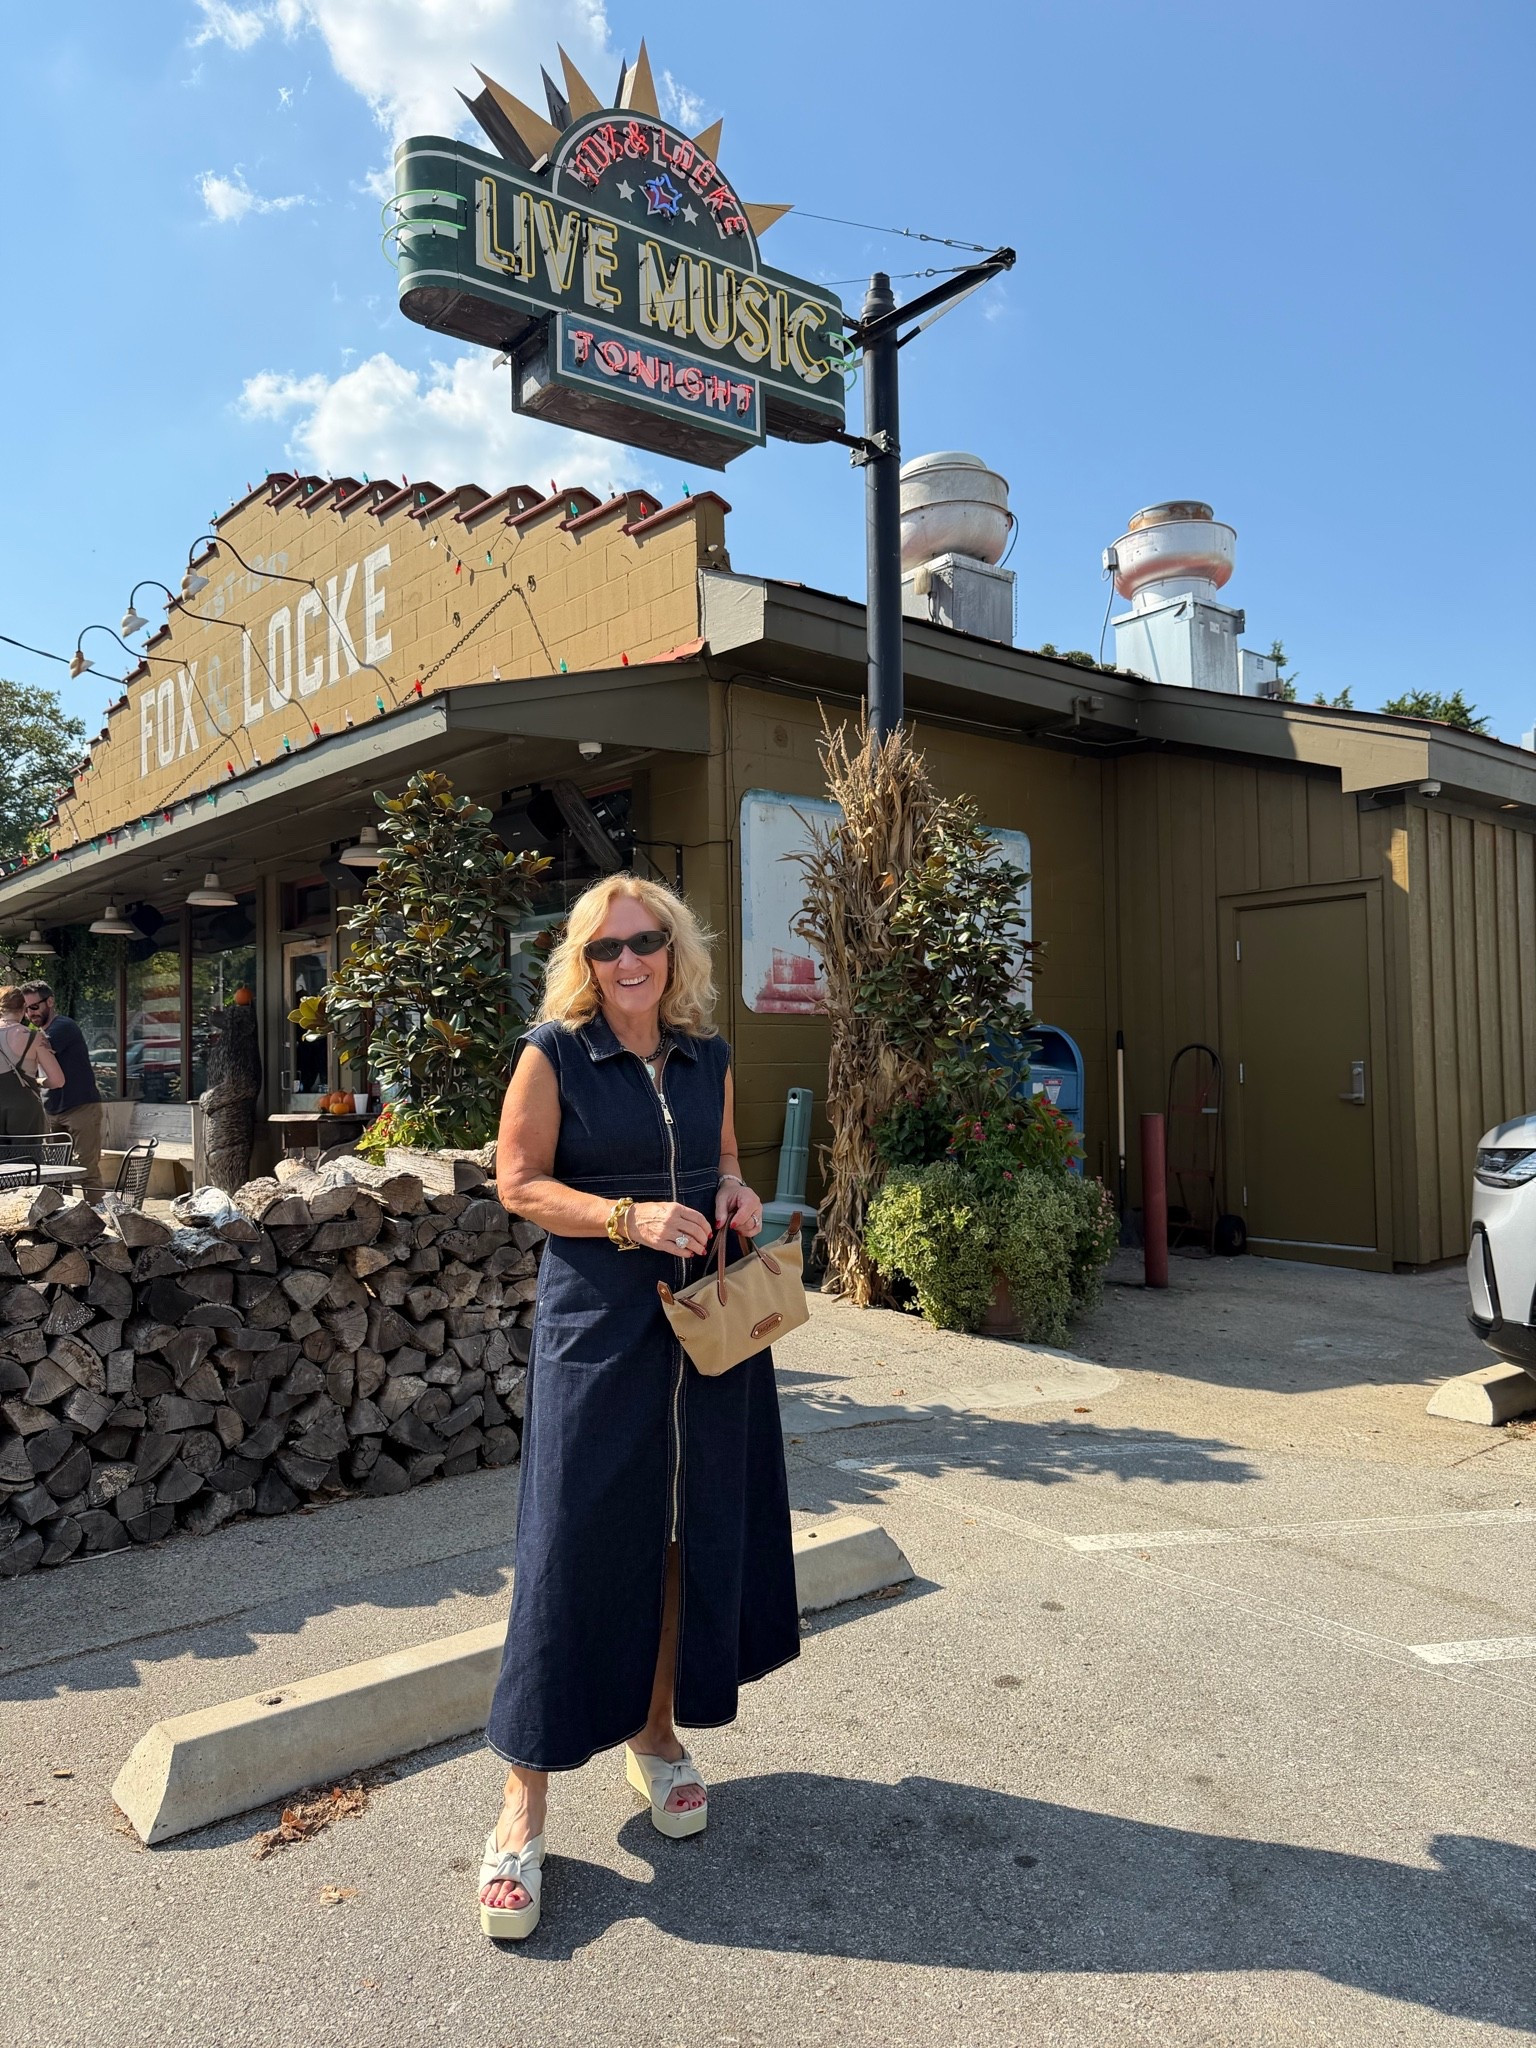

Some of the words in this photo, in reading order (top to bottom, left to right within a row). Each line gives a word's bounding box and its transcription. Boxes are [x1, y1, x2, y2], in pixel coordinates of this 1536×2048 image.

[651, 127, 748, 240] LOCKE
[475, 176, 622, 313] LIVE
[638, 241, 831, 384] MUSIC
[567, 330, 754, 416] TONIGHT
[140, 661, 199, 778] FOX
[205, 655, 232, 737] &
[242, 543, 393, 726] LOCKE
